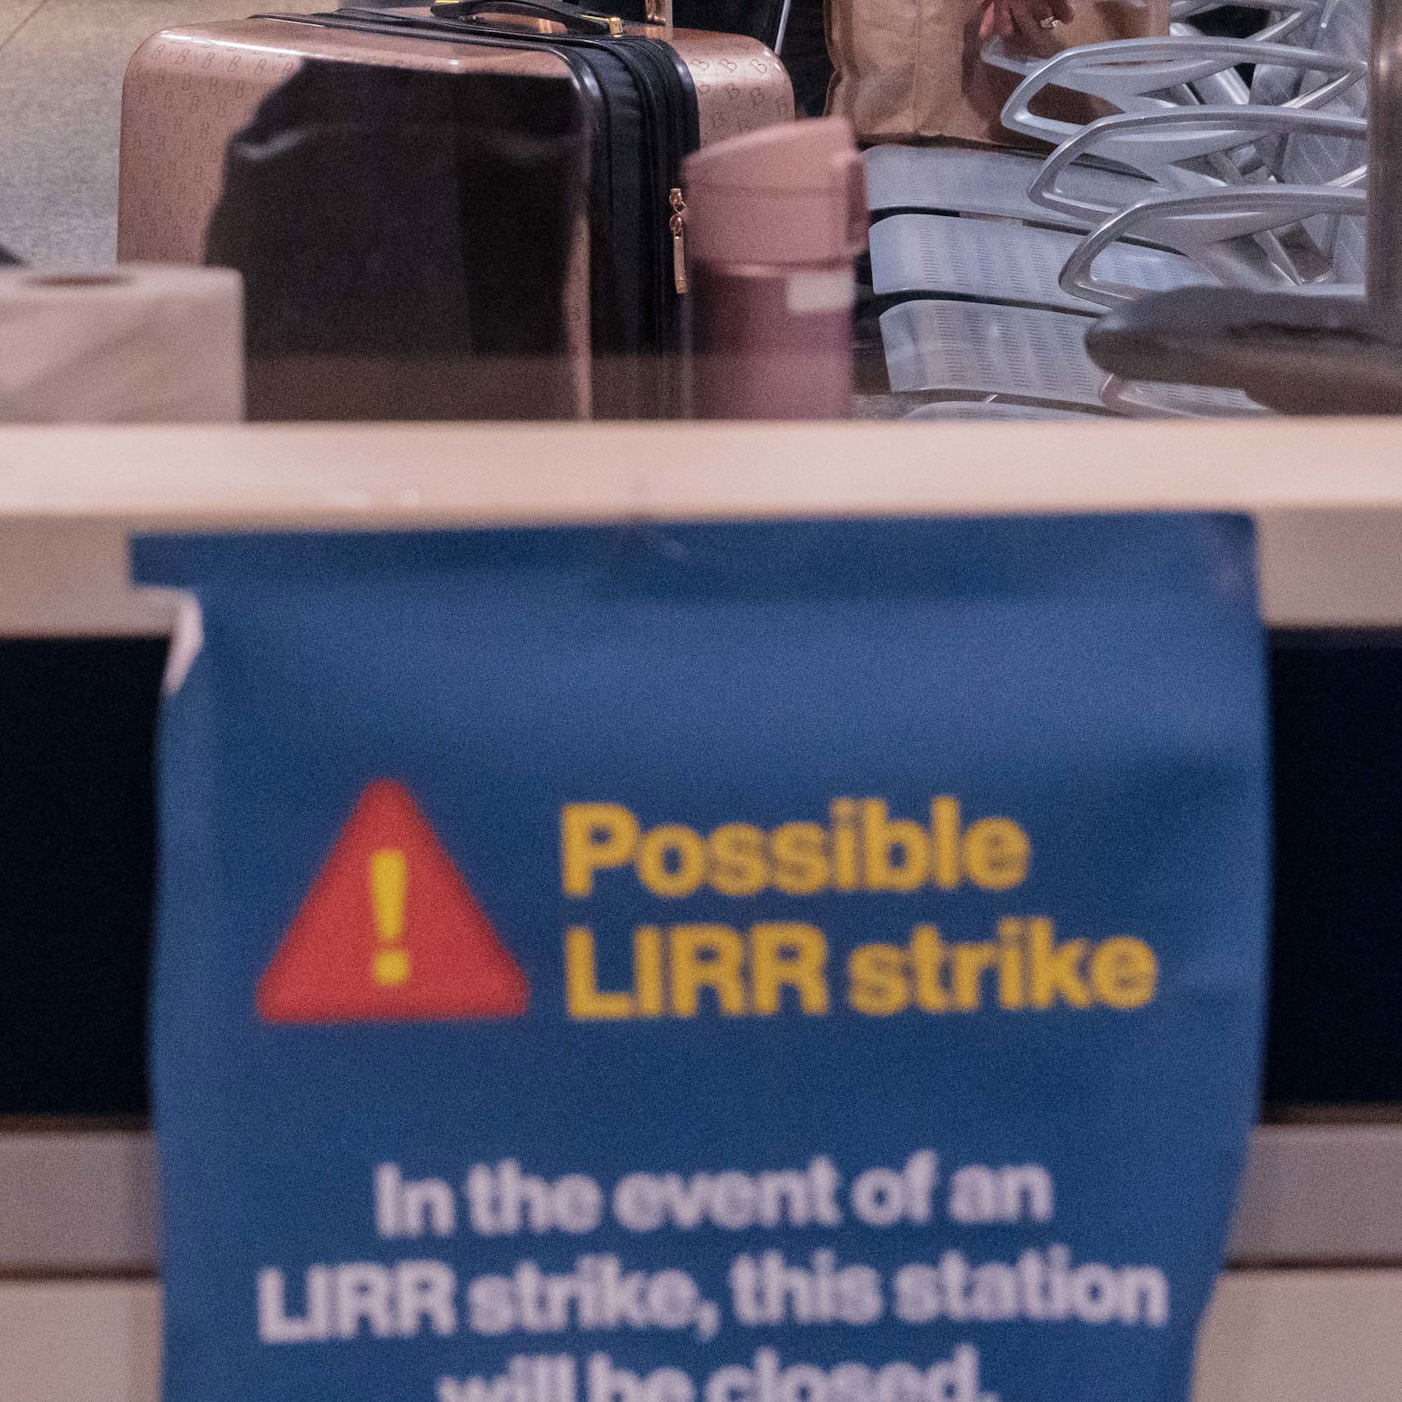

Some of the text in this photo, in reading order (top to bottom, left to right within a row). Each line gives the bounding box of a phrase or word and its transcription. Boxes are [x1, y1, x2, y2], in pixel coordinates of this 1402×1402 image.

[559, 794, 1034, 899] Possible
[563, 916, 1160, 1022] LIRR strike
[372, 1147, 1056, 1240] In the event of an
[255, 1241, 1171, 1345] LIRR strike, this station
[584, 1348, 693, 1402] be
